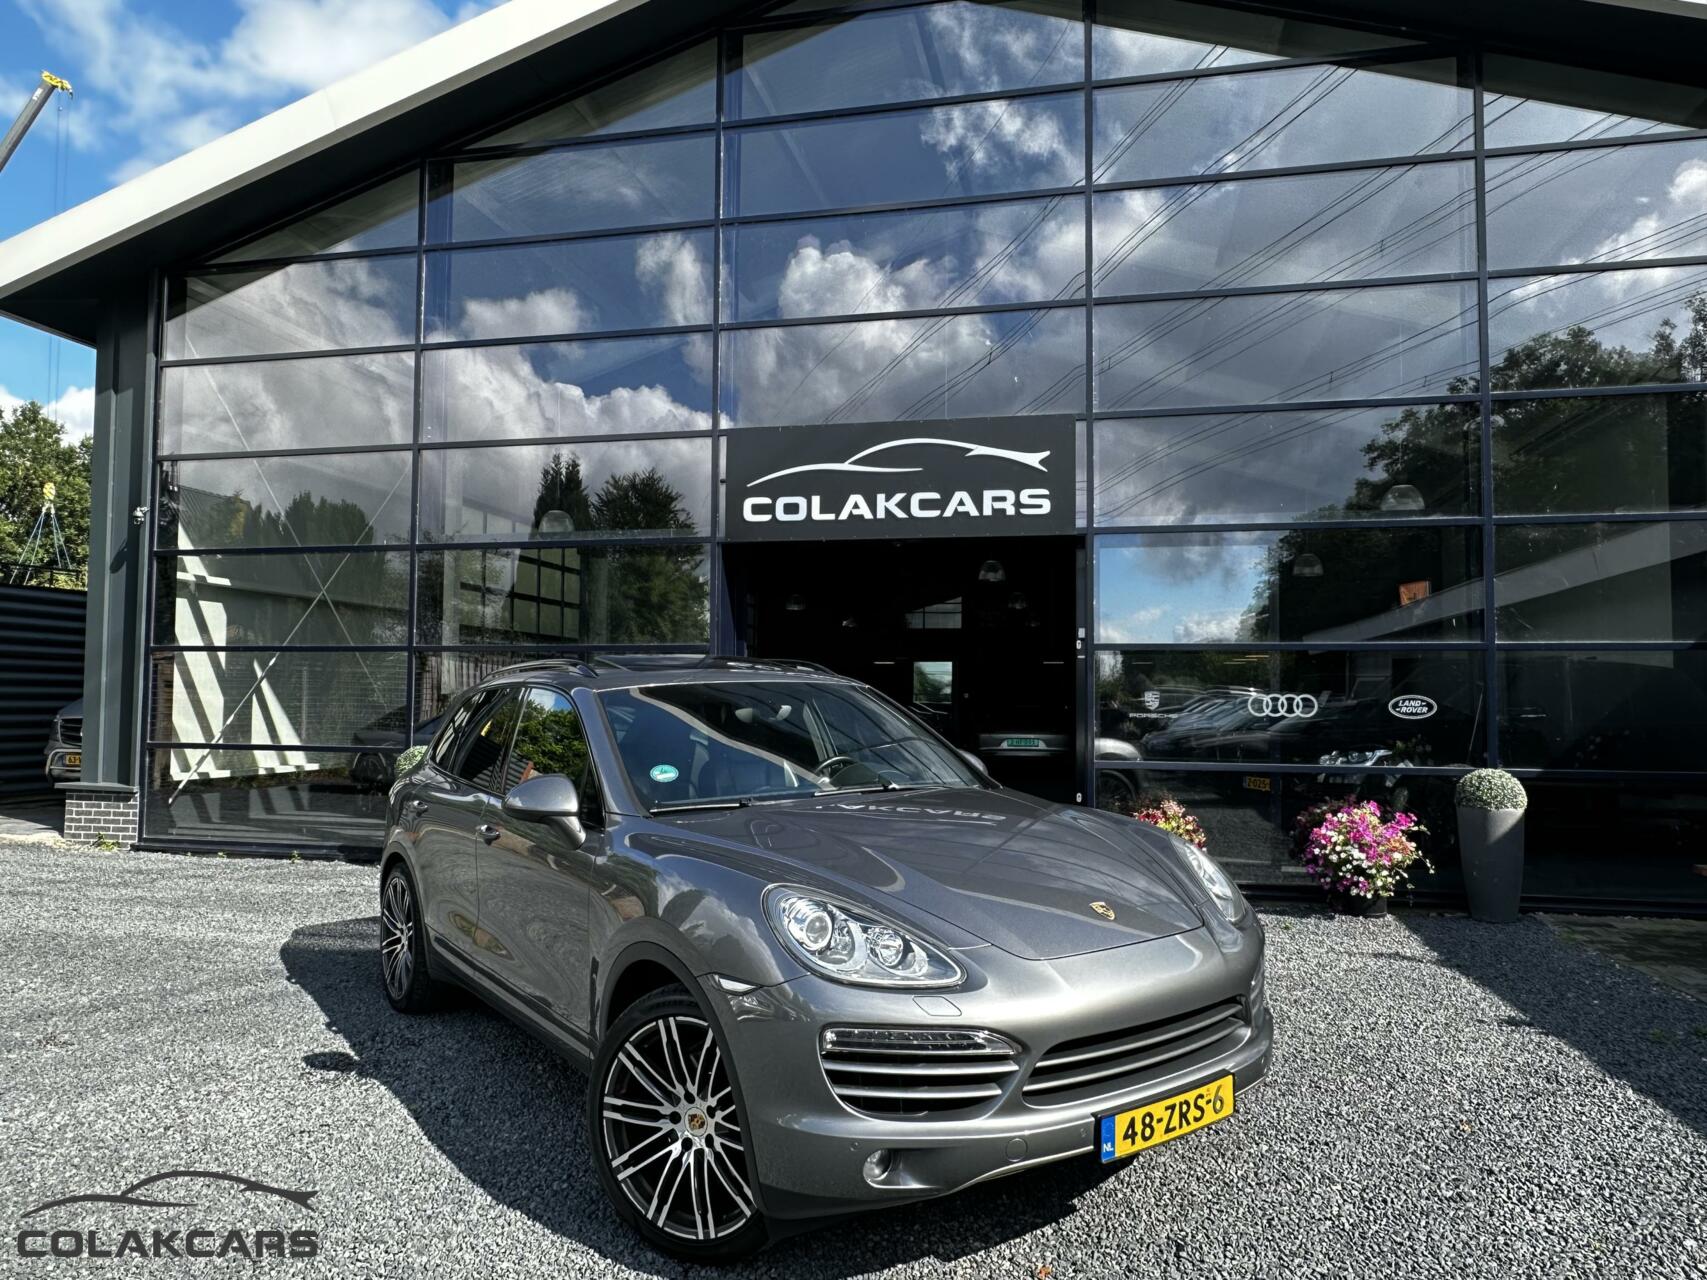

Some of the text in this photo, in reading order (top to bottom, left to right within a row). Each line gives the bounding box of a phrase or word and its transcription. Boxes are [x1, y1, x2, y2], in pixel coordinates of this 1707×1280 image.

[743, 488, 1052, 522] COLAKCARS
[1122, 1084, 1225, 1146] 48-ZRS-6
[1103, 1143, 1114, 1153] NL
